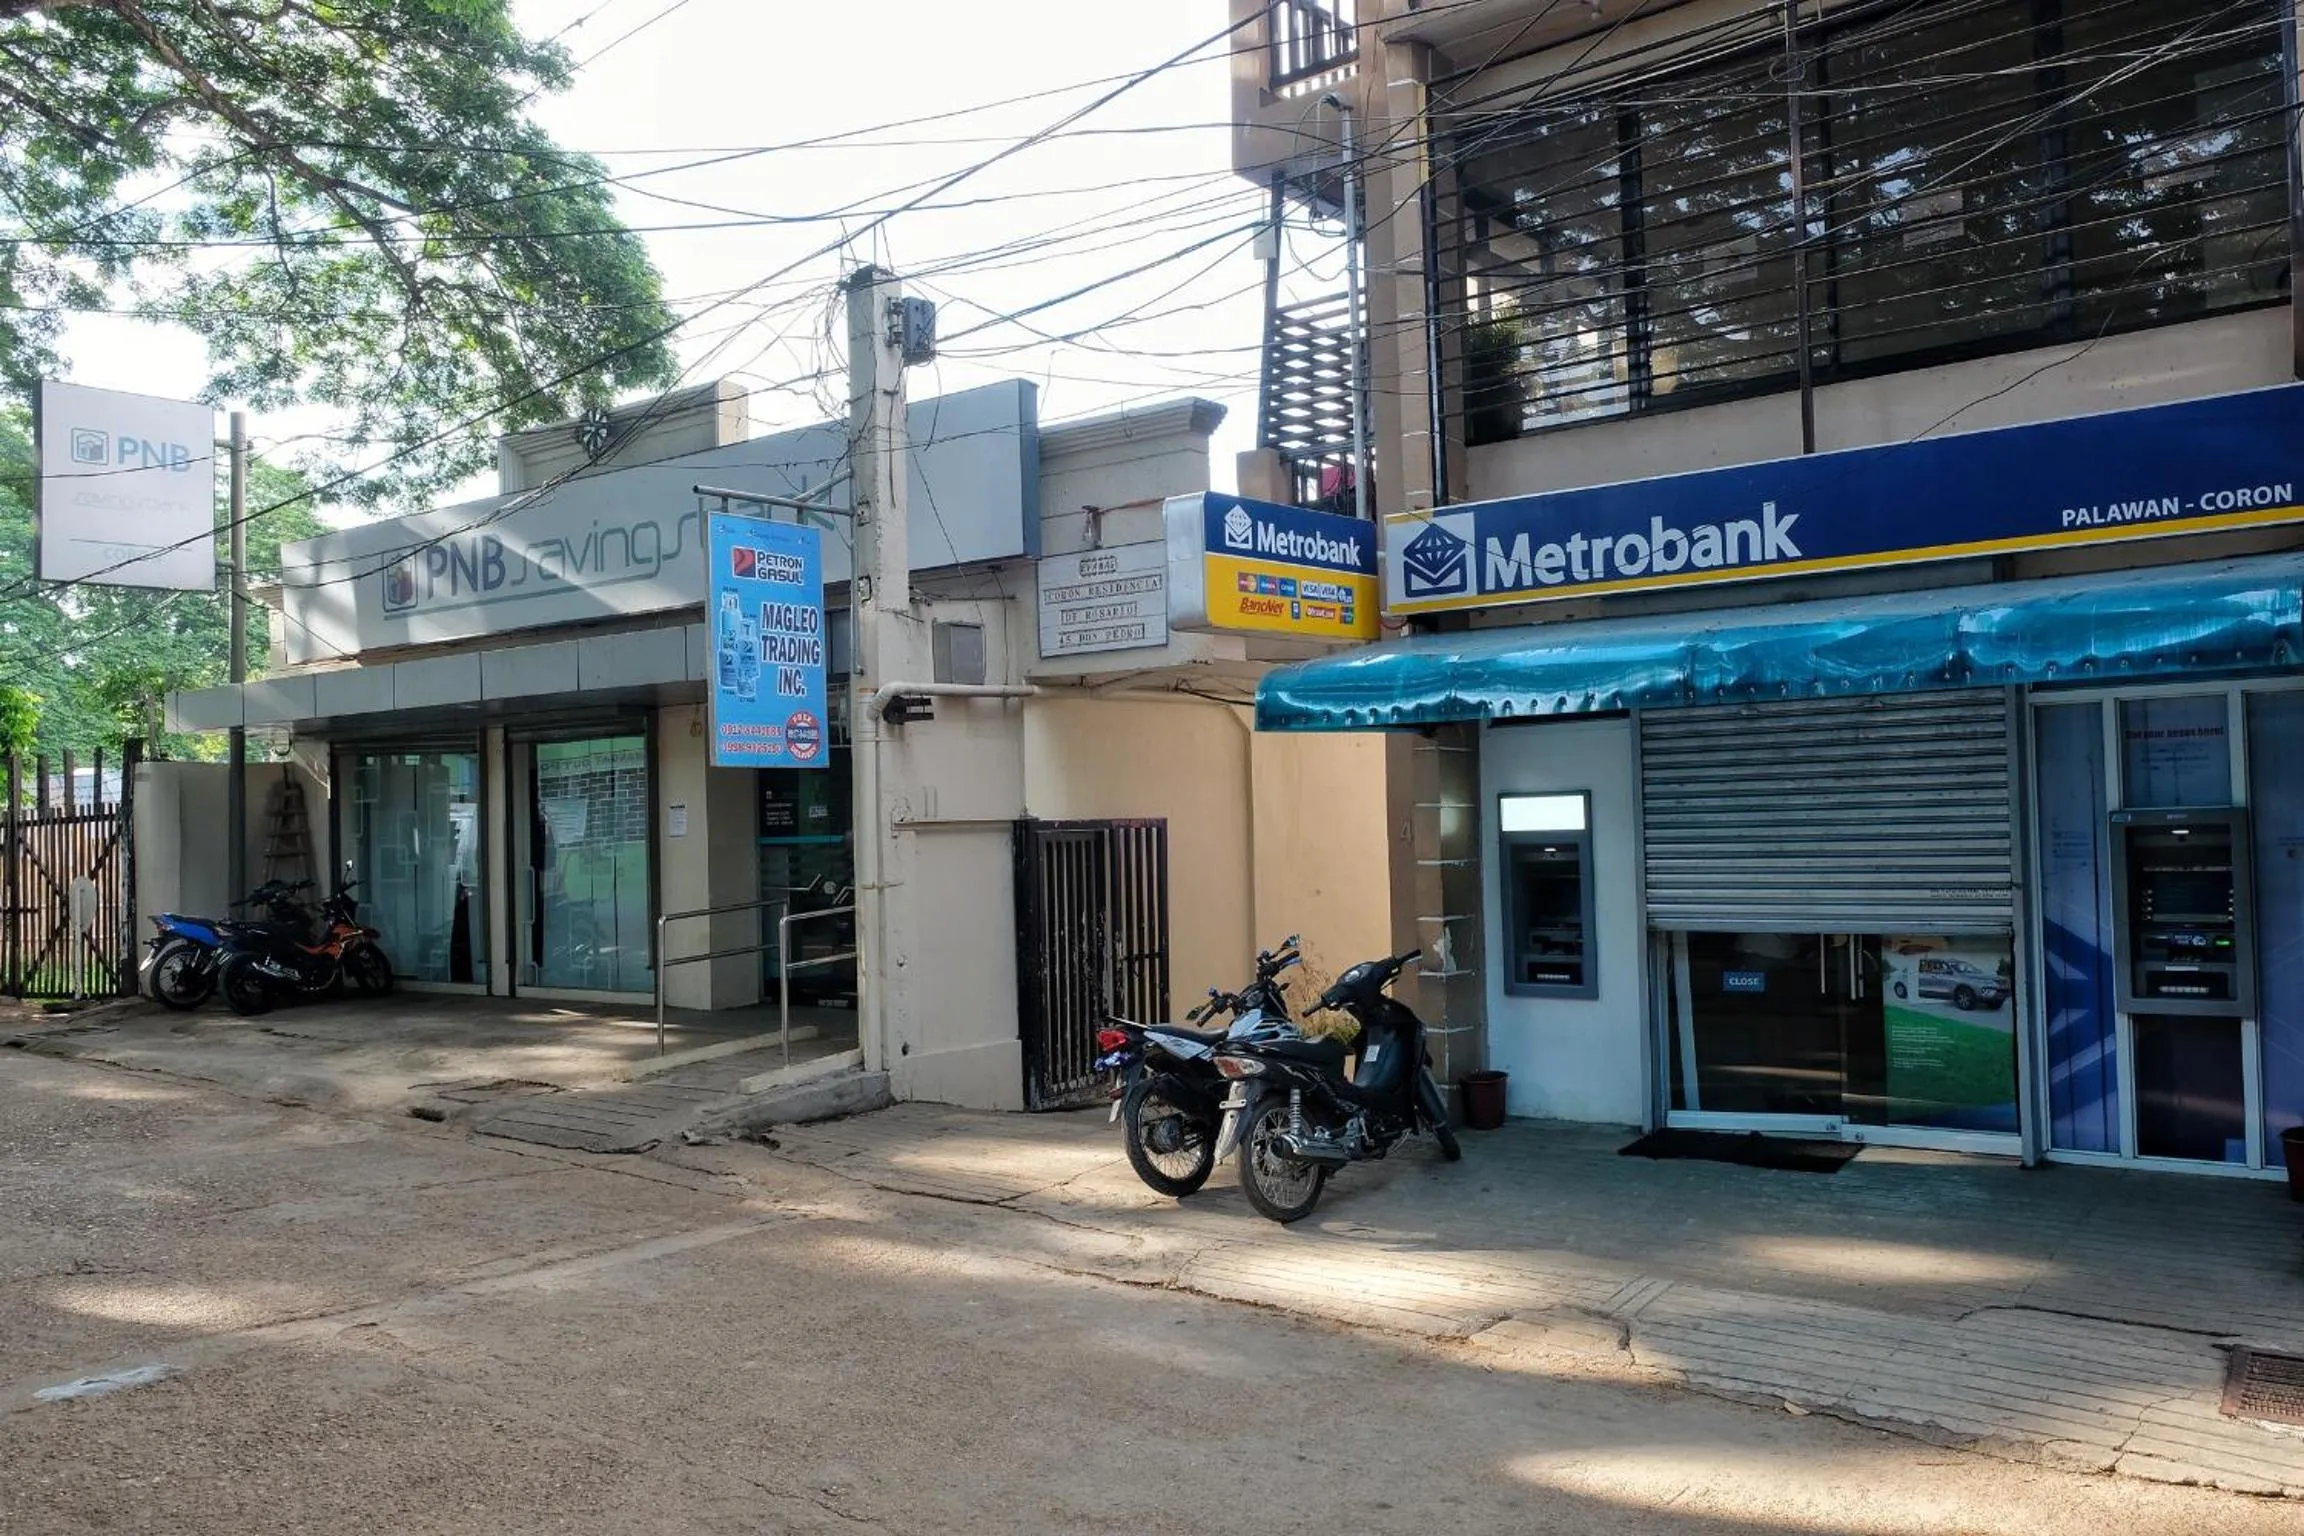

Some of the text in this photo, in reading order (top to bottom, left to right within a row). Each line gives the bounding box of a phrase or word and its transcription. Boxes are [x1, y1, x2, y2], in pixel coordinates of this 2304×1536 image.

[117, 436, 192, 473] PNB
[2061, 495, 2180, 529] PALAWAN
[2199, 482, 2294, 516] CORON
[1257, 520, 1361, 567] Metrobank
[1484, 500, 1803, 595] Metrobank
[426, 533, 507, 601] PNB
[757, 551, 803, 569] PETRON
[757, 569, 803, 585] GASUL
[761, 603, 818, 634] MAGLEO
[761, 635, 821, 666] TRADING
[778, 667, 806, 695] INC.
[1728, 977, 1759, 986] CLOSE
